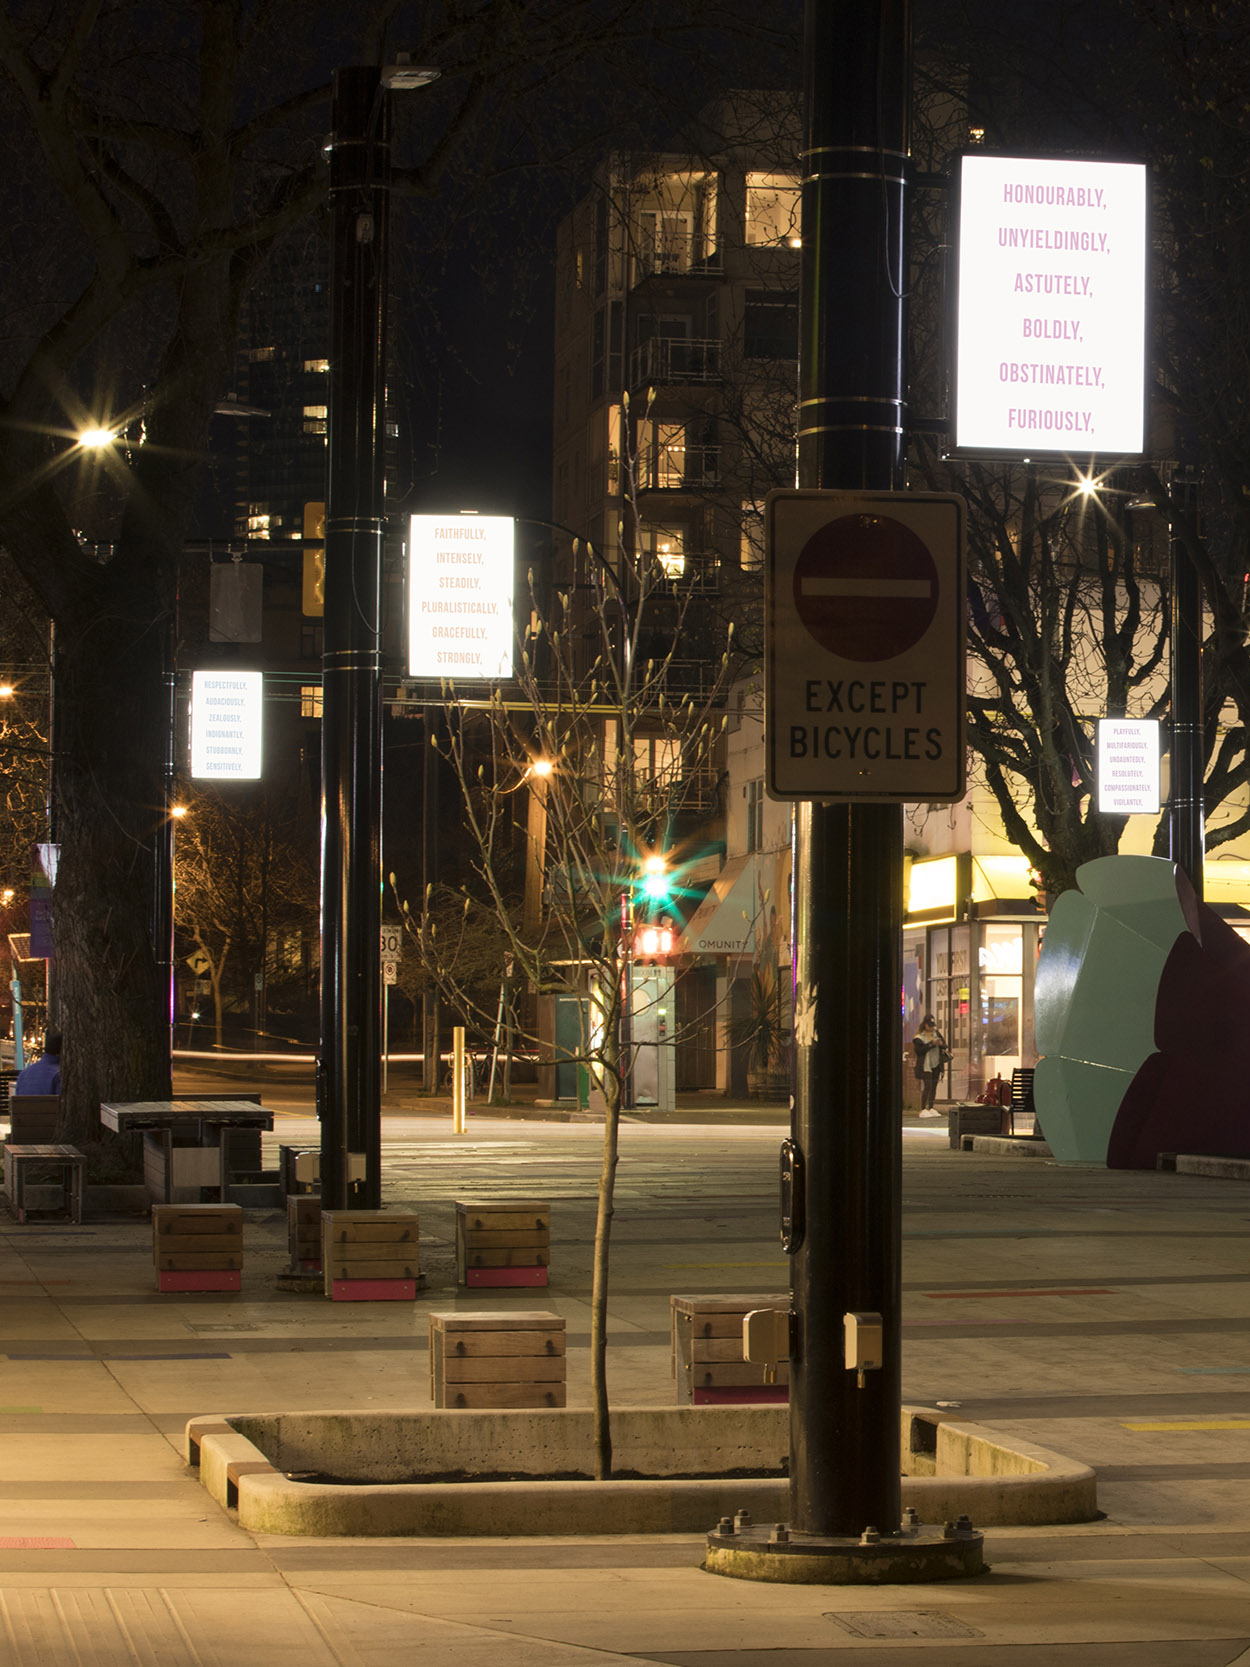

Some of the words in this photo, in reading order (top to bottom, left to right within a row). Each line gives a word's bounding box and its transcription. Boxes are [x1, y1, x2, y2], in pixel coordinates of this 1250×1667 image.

[1003, 184, 1107, 210] HONOURABLY,
[998, 227, 1111, 255] UNYIELDINGLY,
[1014, 273, 1094, 298] ASTUTELY,
[1022, 318, 1084, 343] BOLDLY,
[999, 362, 1105, 390] OBSTINATELY,
[1008, 408, 1095, 434] FURIOUSLY,
[434, 527, 487, 541] FAITHFULLY,
[436, 552, 484, 565] INTENSELY,
[439, 577, 481, 590] STEADILY,
[421, 601, 499, 615] PLURALISTICALLY,
[432, 626, 488, 640] GRACEFULLY,
[437, 651, 483, 665] STRONGLY,
[805, 679, 927, 714] EXCEPT
[789, 725, 943, 760] BICYCLES
